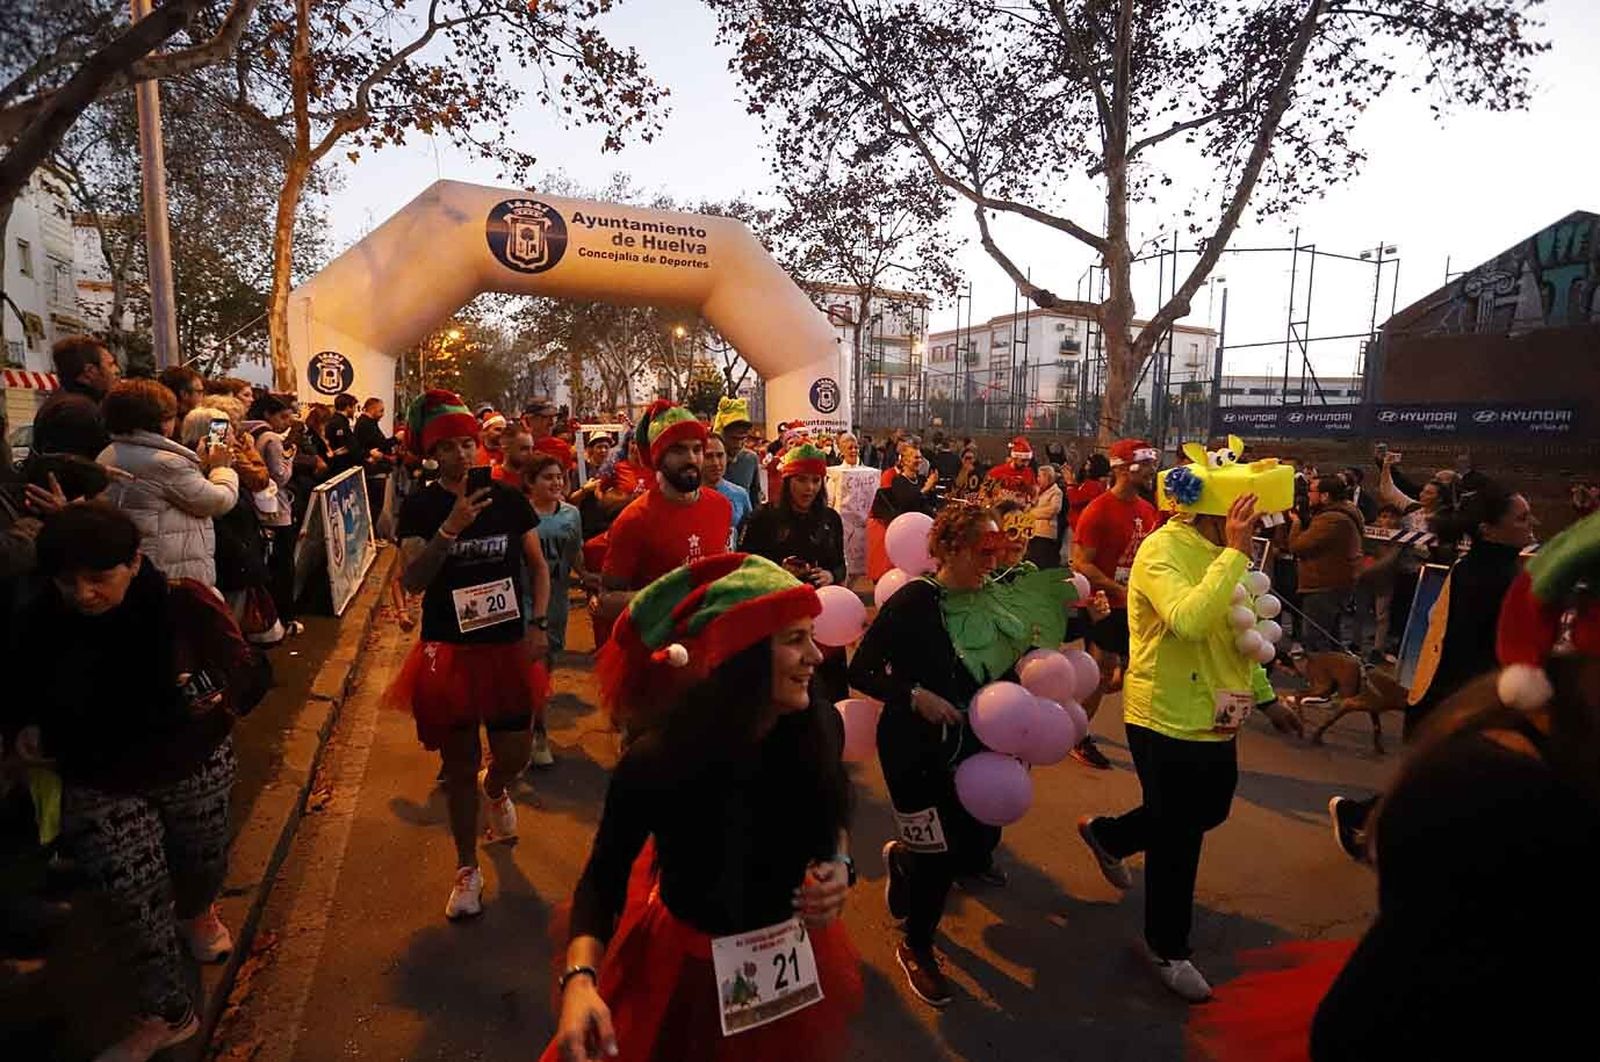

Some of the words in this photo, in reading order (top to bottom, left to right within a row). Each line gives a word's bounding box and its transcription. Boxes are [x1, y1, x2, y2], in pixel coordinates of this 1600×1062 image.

[571, 211, 707, 239] Ayuntamiento
[612, 231, 636, 248] de
[642, 234, 707, 255] Huelva
[643, 253, 657, 264] de
[659, 255, 709, 269] Deportes
[1238, 413, 1278, 421] HYUNDAI
[1306, 412, 1352, 421] HYUNDAI
[1400, 411, 1458, 422] HYUNDAI
[1501, 410, 1571, 423] HYUNDAI
[486, 594, 506, 613] 20
[903, 824, 935, 842] 421
[772, 946, 800, 991] 21
